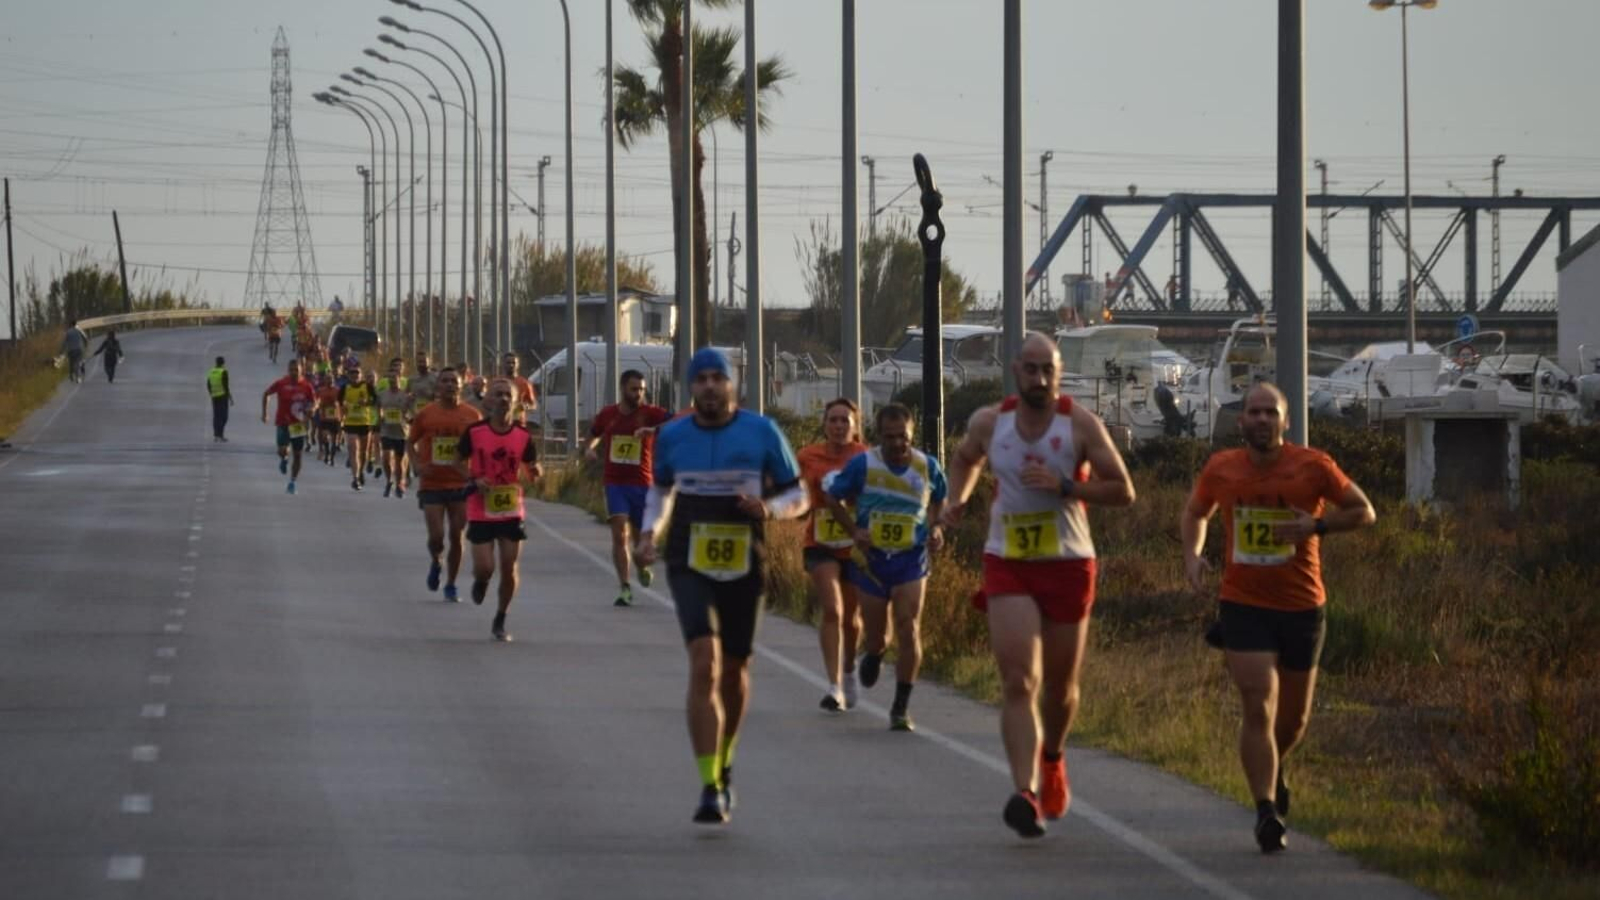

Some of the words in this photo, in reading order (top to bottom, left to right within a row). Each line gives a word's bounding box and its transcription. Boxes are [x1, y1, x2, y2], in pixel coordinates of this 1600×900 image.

[618, 443, 633, 455] 47
[494, 493, 511, 508] 64
[881, 523, 903, 542] 59
[1015, 525, 1042, 549] 37
[706, 538, 735, 563] 68
